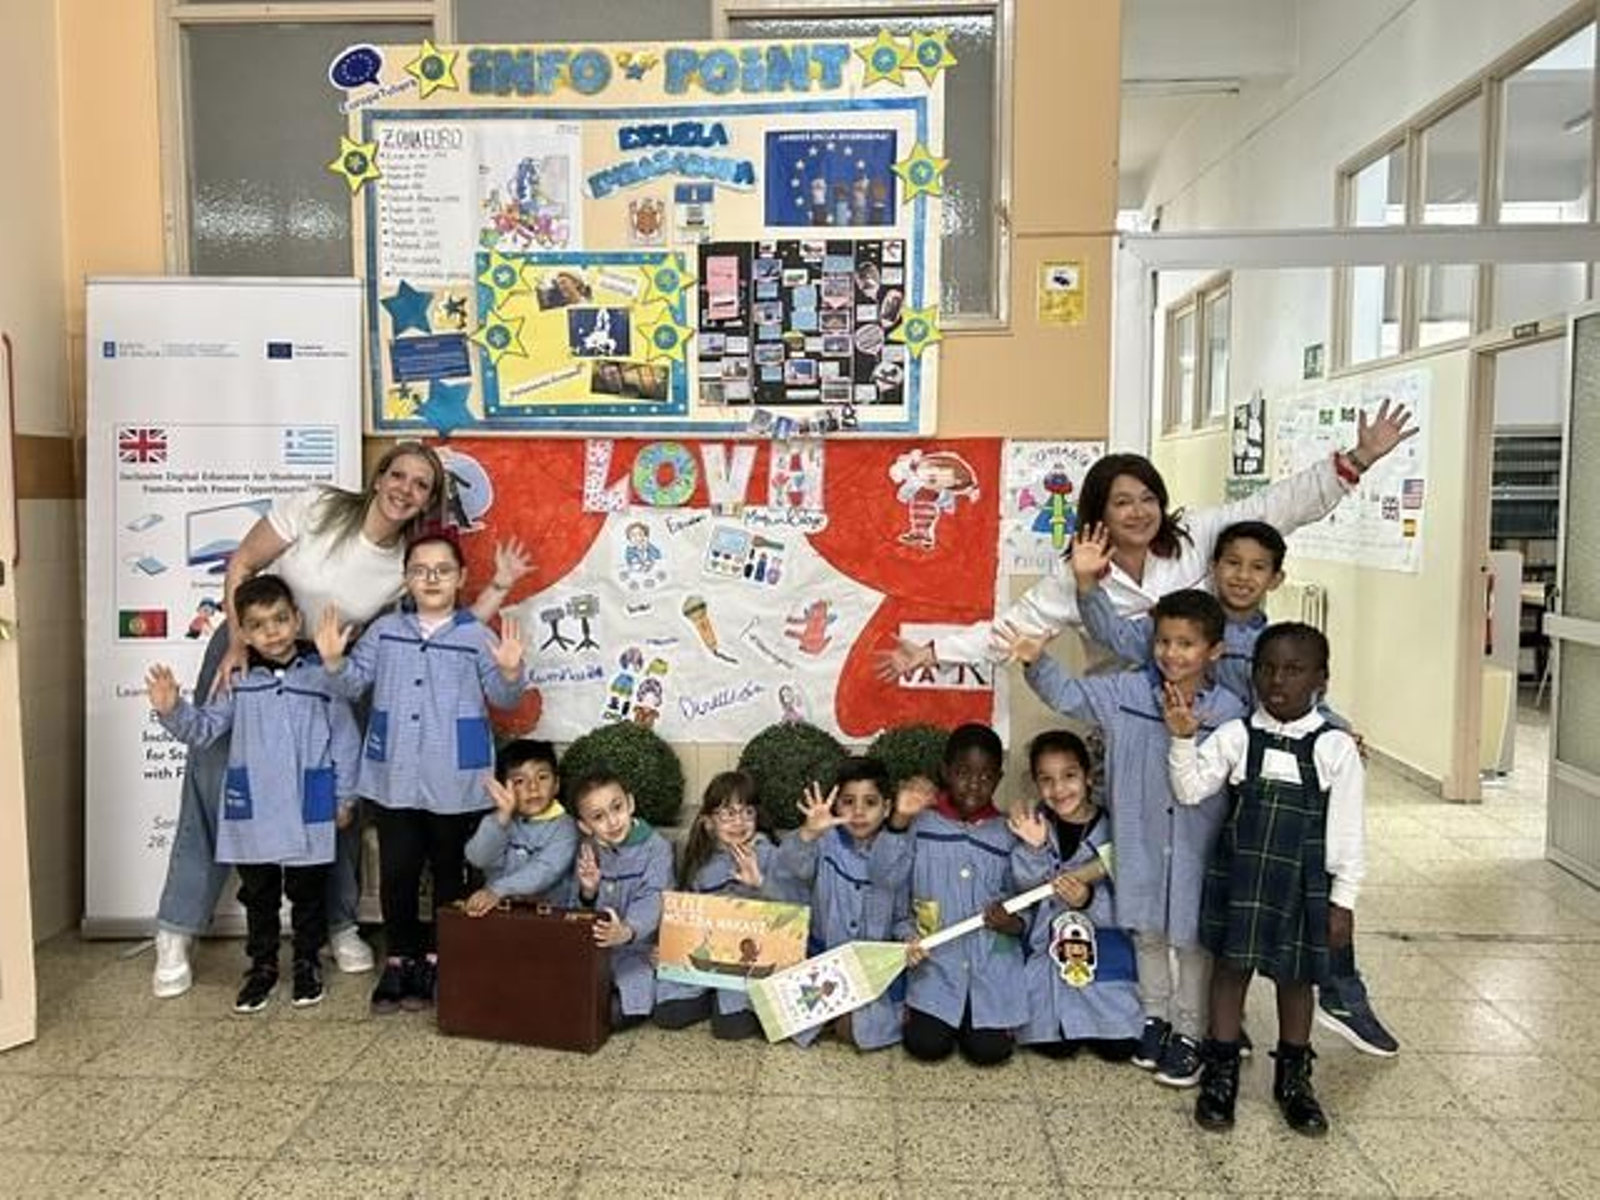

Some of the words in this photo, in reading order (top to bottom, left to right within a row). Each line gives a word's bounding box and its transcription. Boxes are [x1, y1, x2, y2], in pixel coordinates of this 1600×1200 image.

[618, 121, 728, 150] ESCUELA
[202, 472, 250, 481] Education
[143, 766, 173, 780] with
